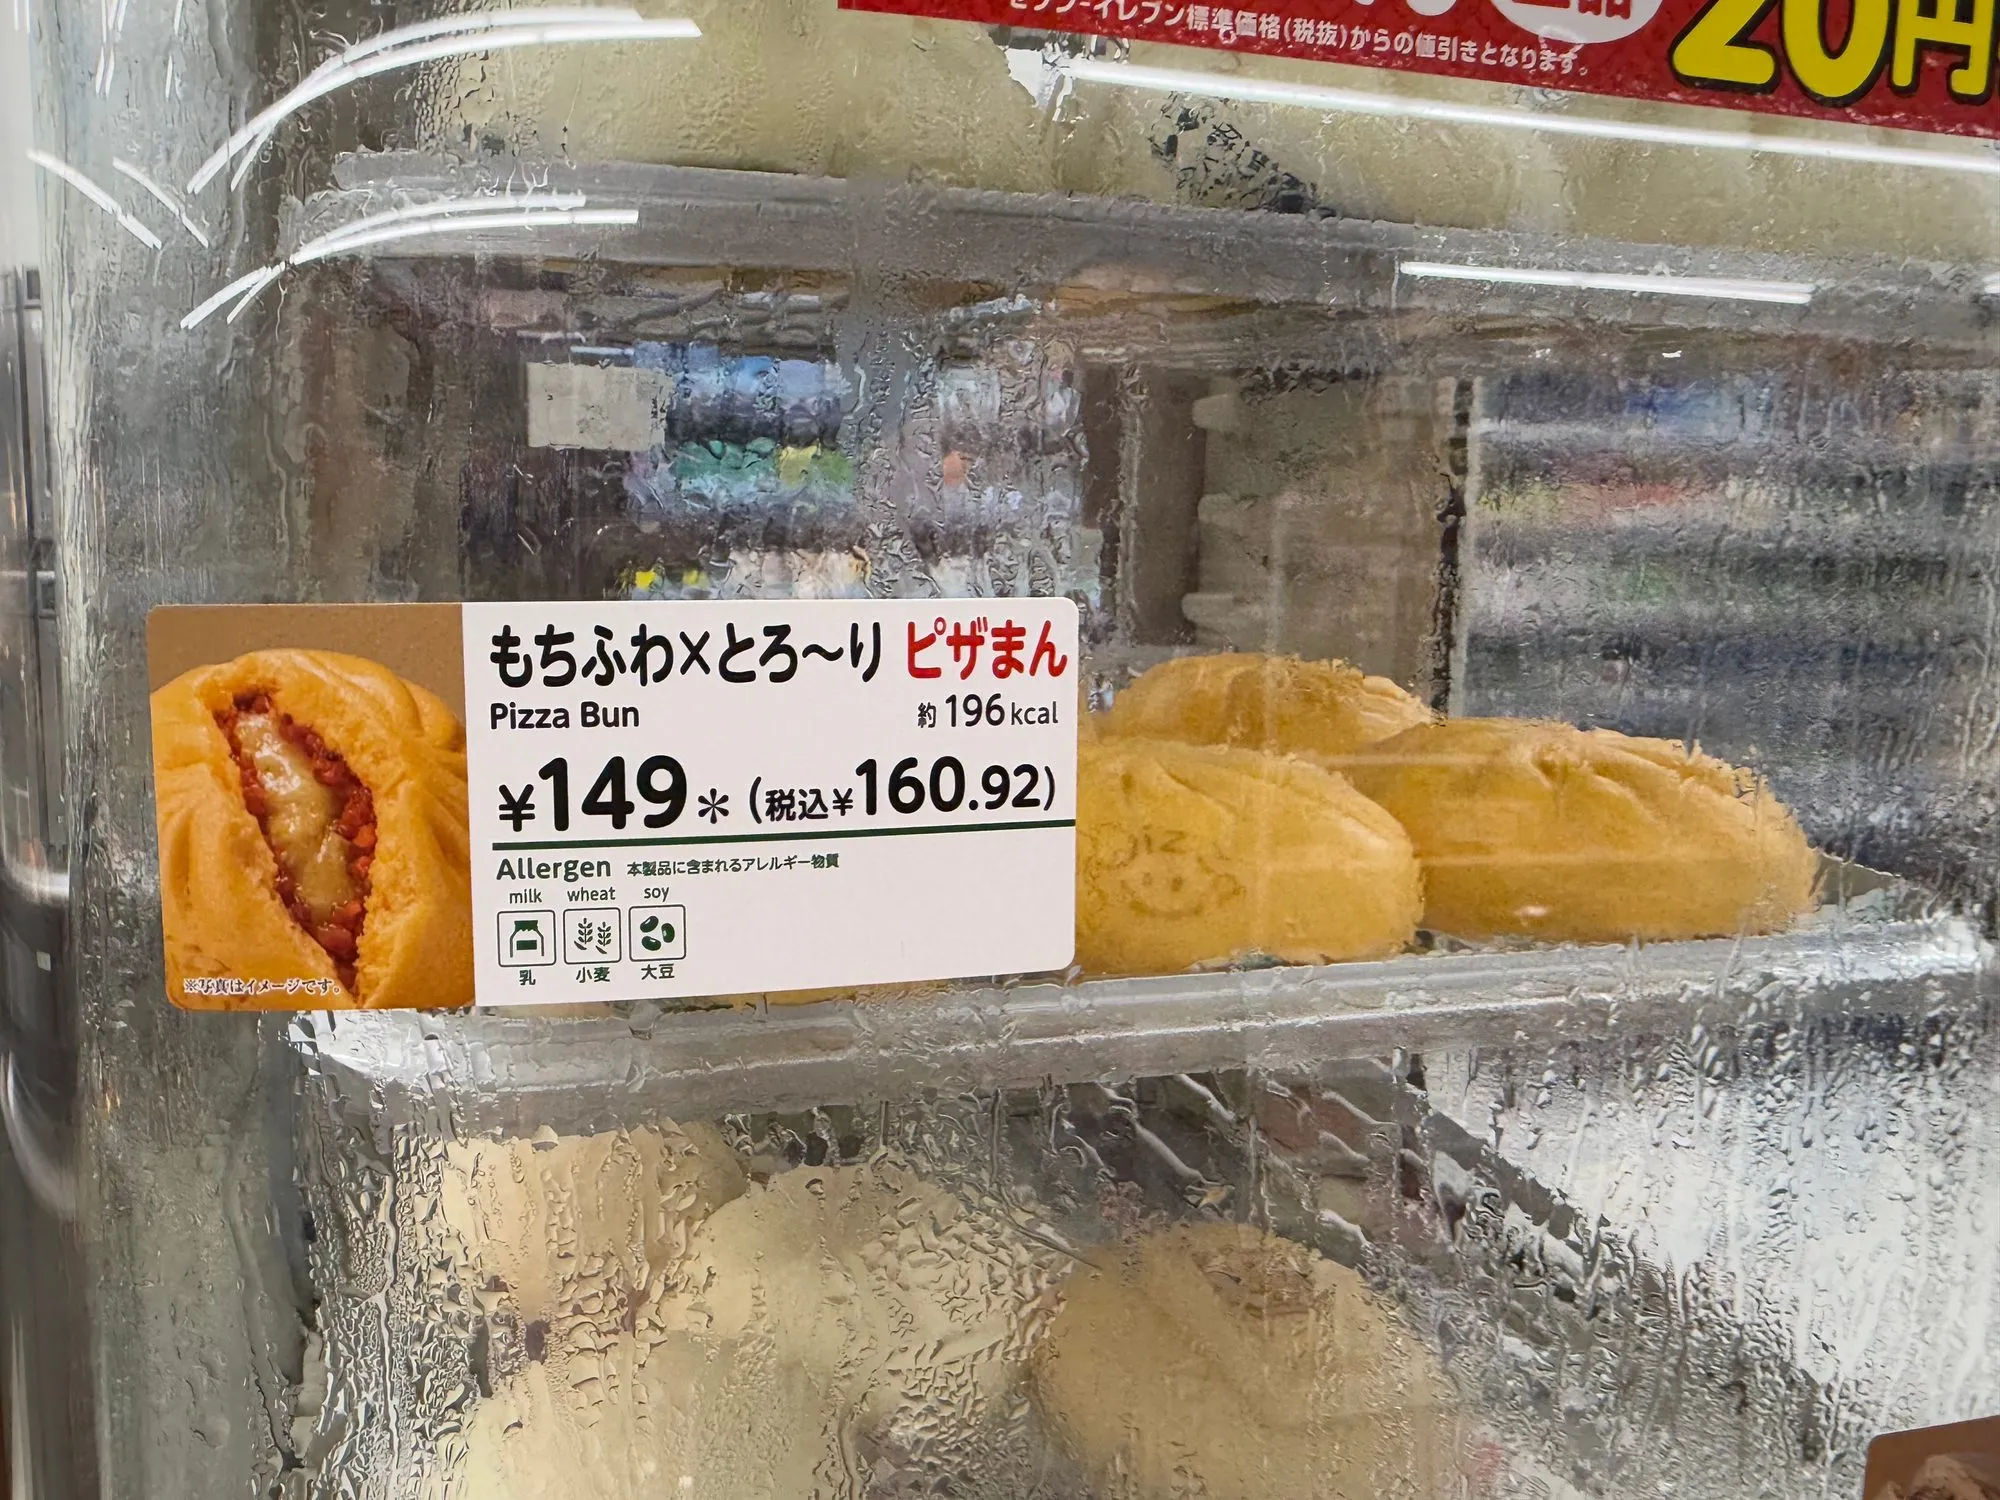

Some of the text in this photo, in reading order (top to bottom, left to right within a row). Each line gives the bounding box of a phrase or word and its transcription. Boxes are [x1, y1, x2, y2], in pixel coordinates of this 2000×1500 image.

[907, 616, 1068, 681] ピザまん
[491, 701, 640, 730] Pizza Bun
[917, 693, 1059, 728] 約 196 kcal
[496, 857, 612, 881] Allergen
[626, 853, 839, 877] 本製品に含まれるアレルギー物質
[509, 889, 542, 904] milk
[567, 886, 616, 902] wheat
[643, 885, 670, 902] soy
[518, 969, 537, 986] 乳
[575, 966, 611, 983] 小麦
[640, 964, 675, 980] 大豆
